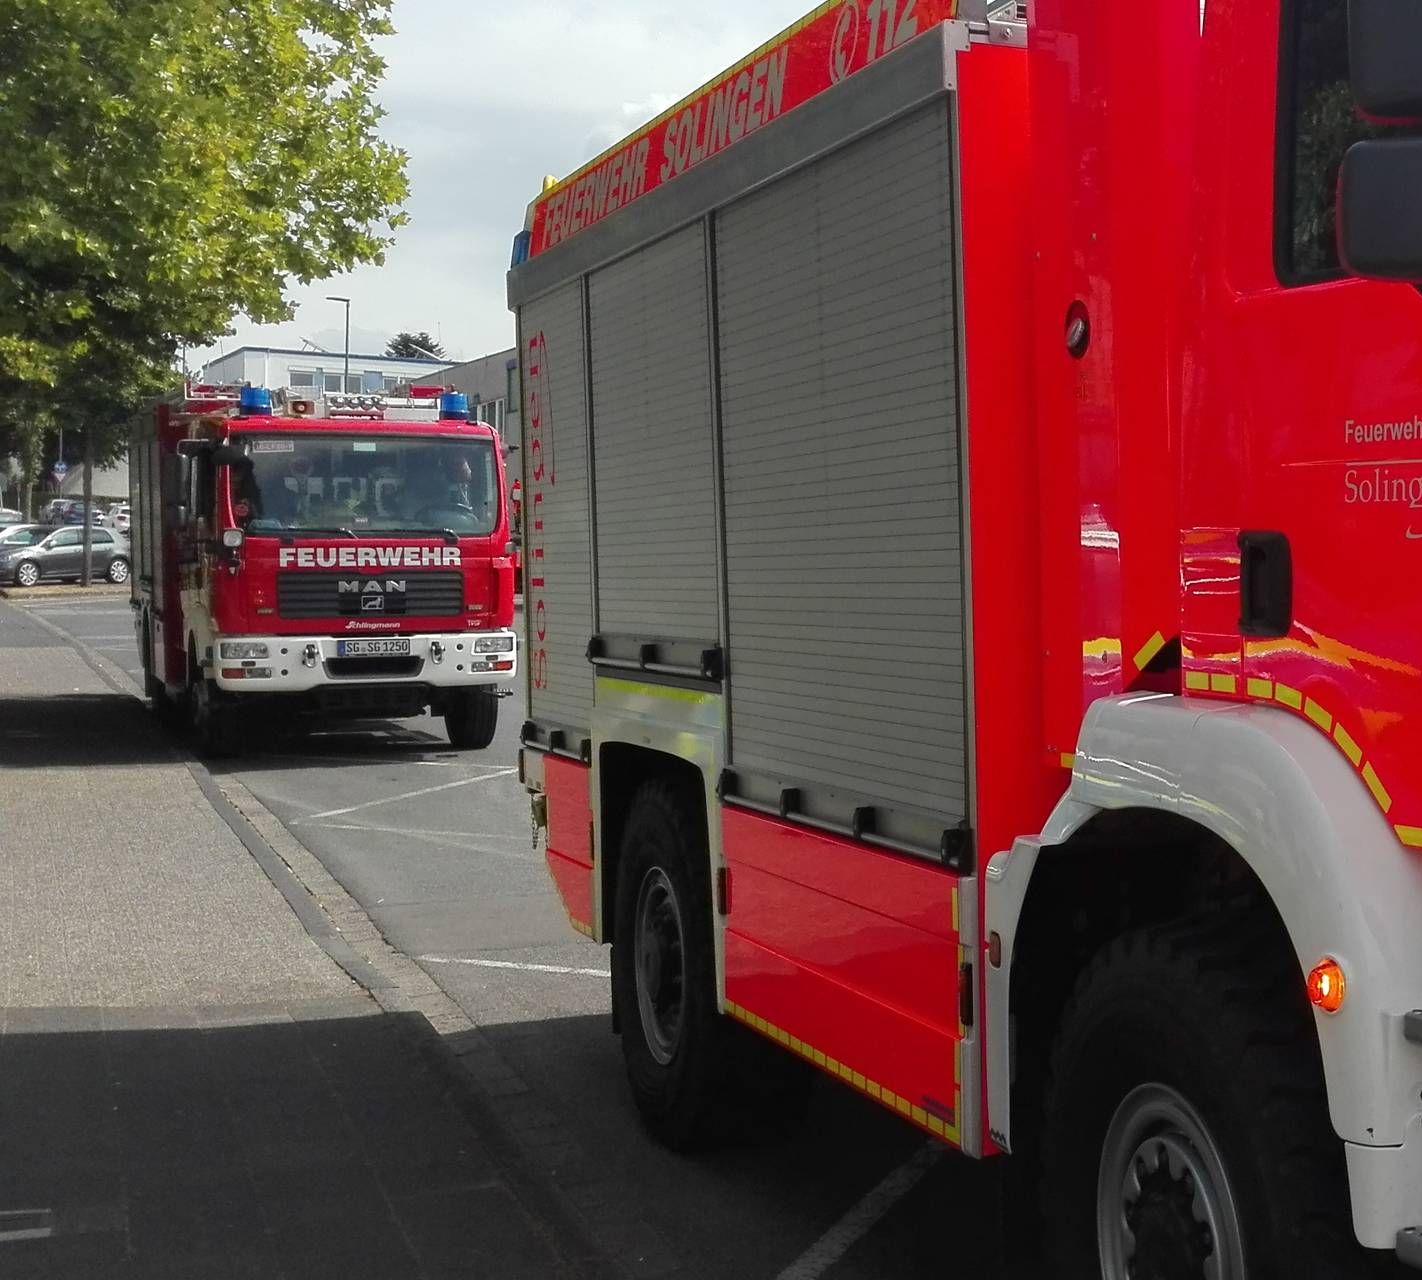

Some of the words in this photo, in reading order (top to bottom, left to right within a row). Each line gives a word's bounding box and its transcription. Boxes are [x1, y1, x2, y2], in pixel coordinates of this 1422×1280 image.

[541, 138, 650, 249] FEUERWEHR
[660, 47, 788, 182] SOLINGEN
[867, 0, 918, 62] 112
[279, 547, 461, 567] FEUERWEHR
[338, 580, 406, 593] MAN
[346, 641, 361, 653] SG
[367, 641, 381, 653] SG
[383, 641, 408, 652] 1250
